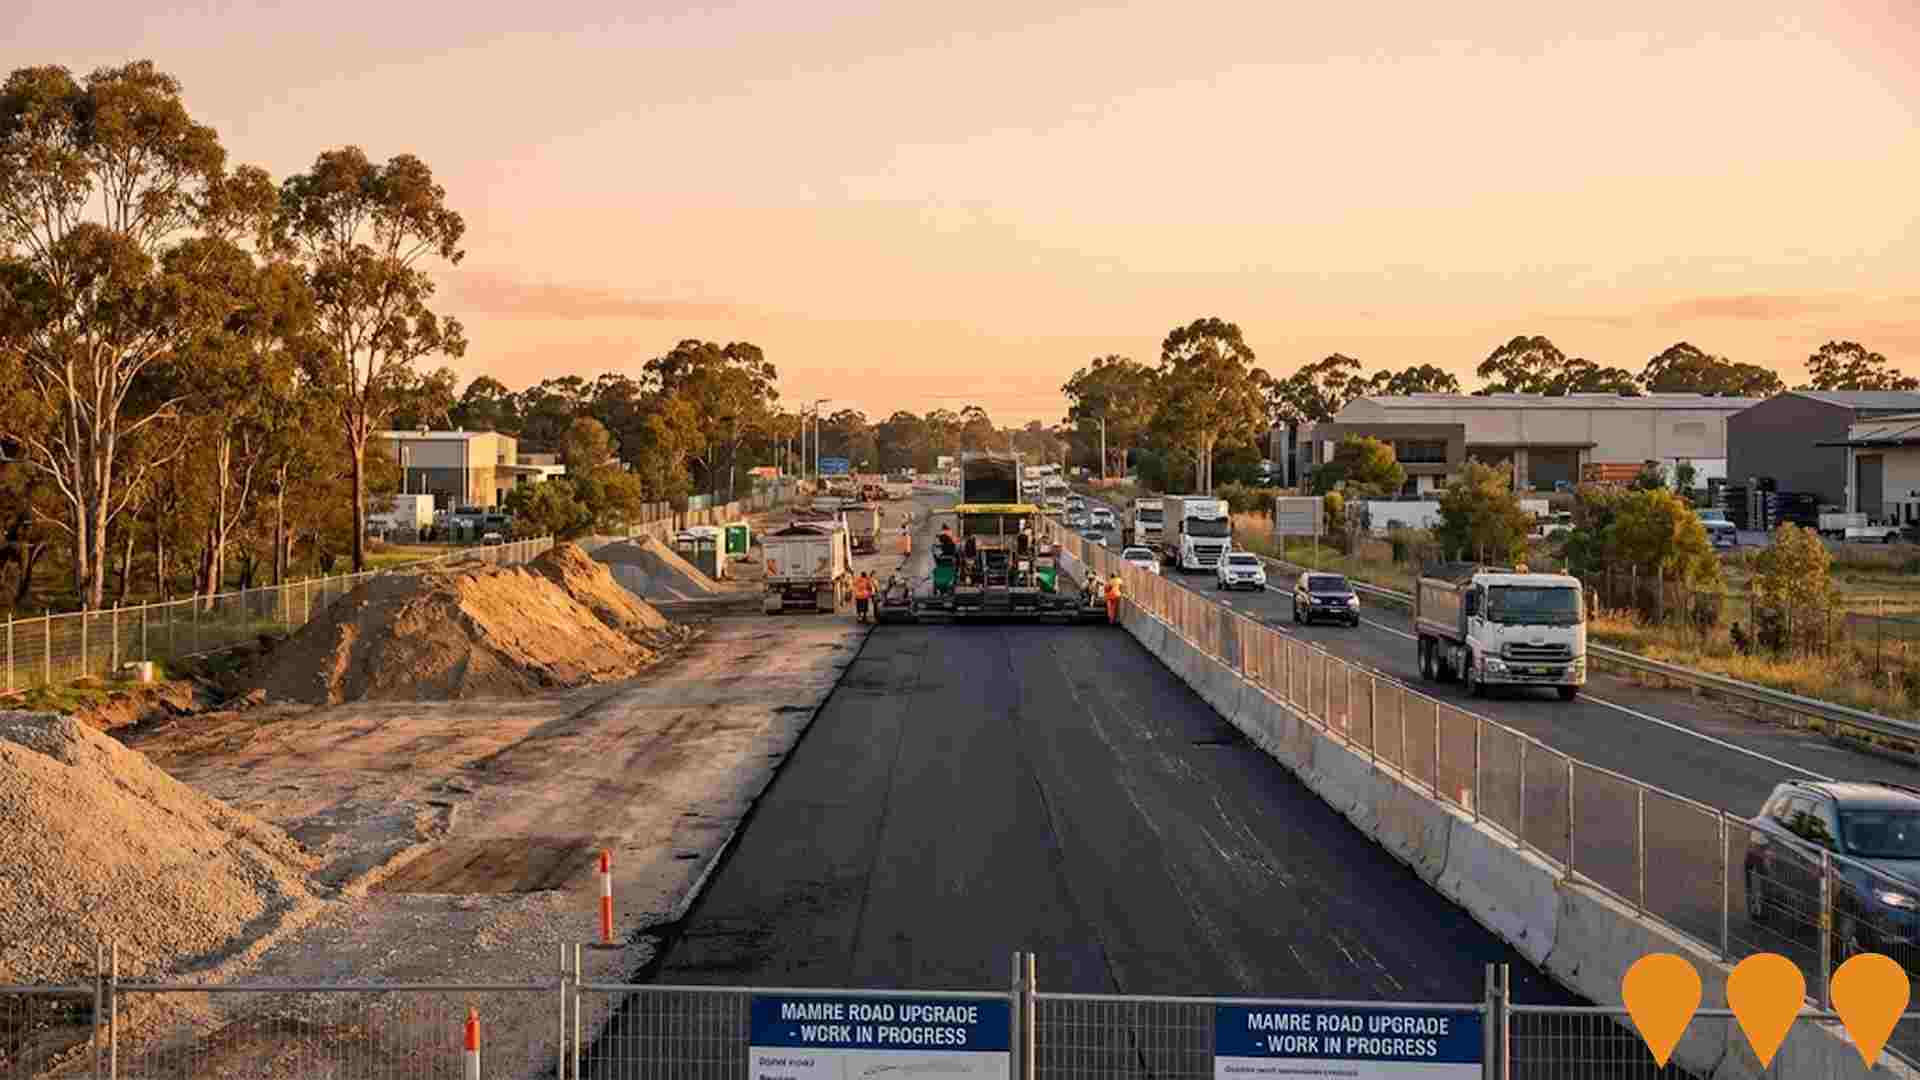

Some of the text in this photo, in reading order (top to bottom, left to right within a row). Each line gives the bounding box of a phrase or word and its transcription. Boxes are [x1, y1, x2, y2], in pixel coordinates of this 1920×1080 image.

[782, 1003, 977, 1024] MAMRE ROAD UPGRADE
[1248, 1013, 1449, 1035] MAMRE ROAD UPGRADE
[801, 1025, 851, 1042] WORK
[856, 1025, 873, 1043] IN
[878, 1026, 967, 1045] PROGRESS
[1267, 1035, 1319, 1053] WORK
[1324, 1036, 1341, 1054] IN
[1346, 1037, 1438, 1056] PROGRESS
